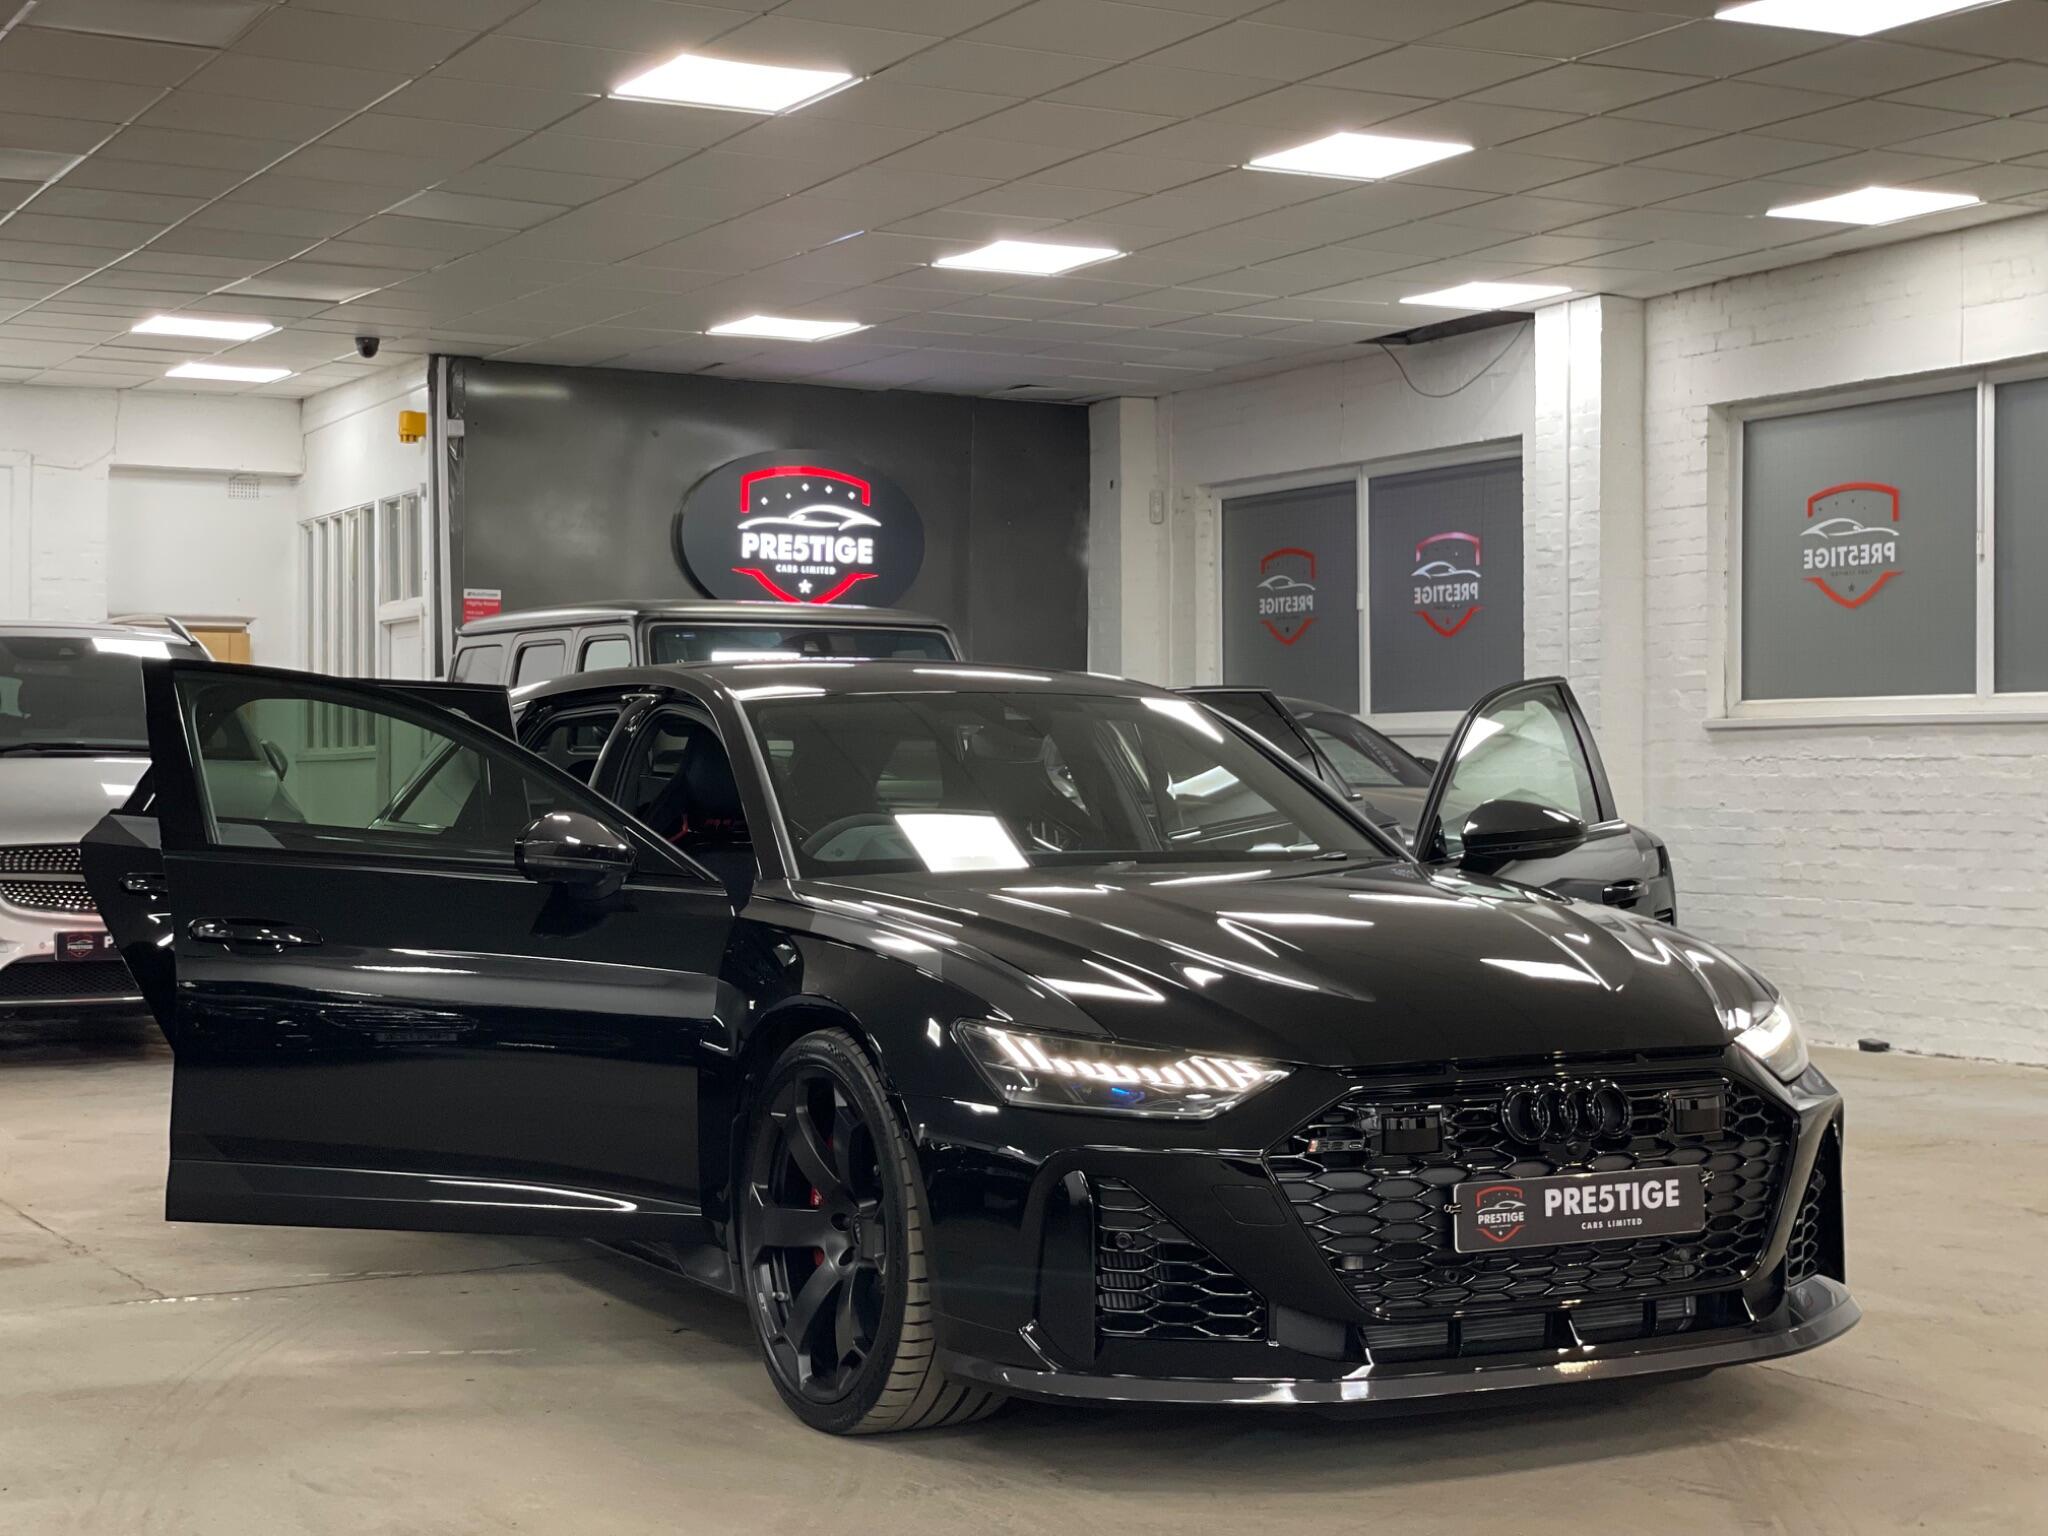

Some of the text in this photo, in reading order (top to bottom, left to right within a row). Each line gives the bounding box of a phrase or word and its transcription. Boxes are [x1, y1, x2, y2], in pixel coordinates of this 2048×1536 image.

[801, 565, 837, 575] LIMITED
[1581, 1217, 1643, 1230] CARS LIMITED
